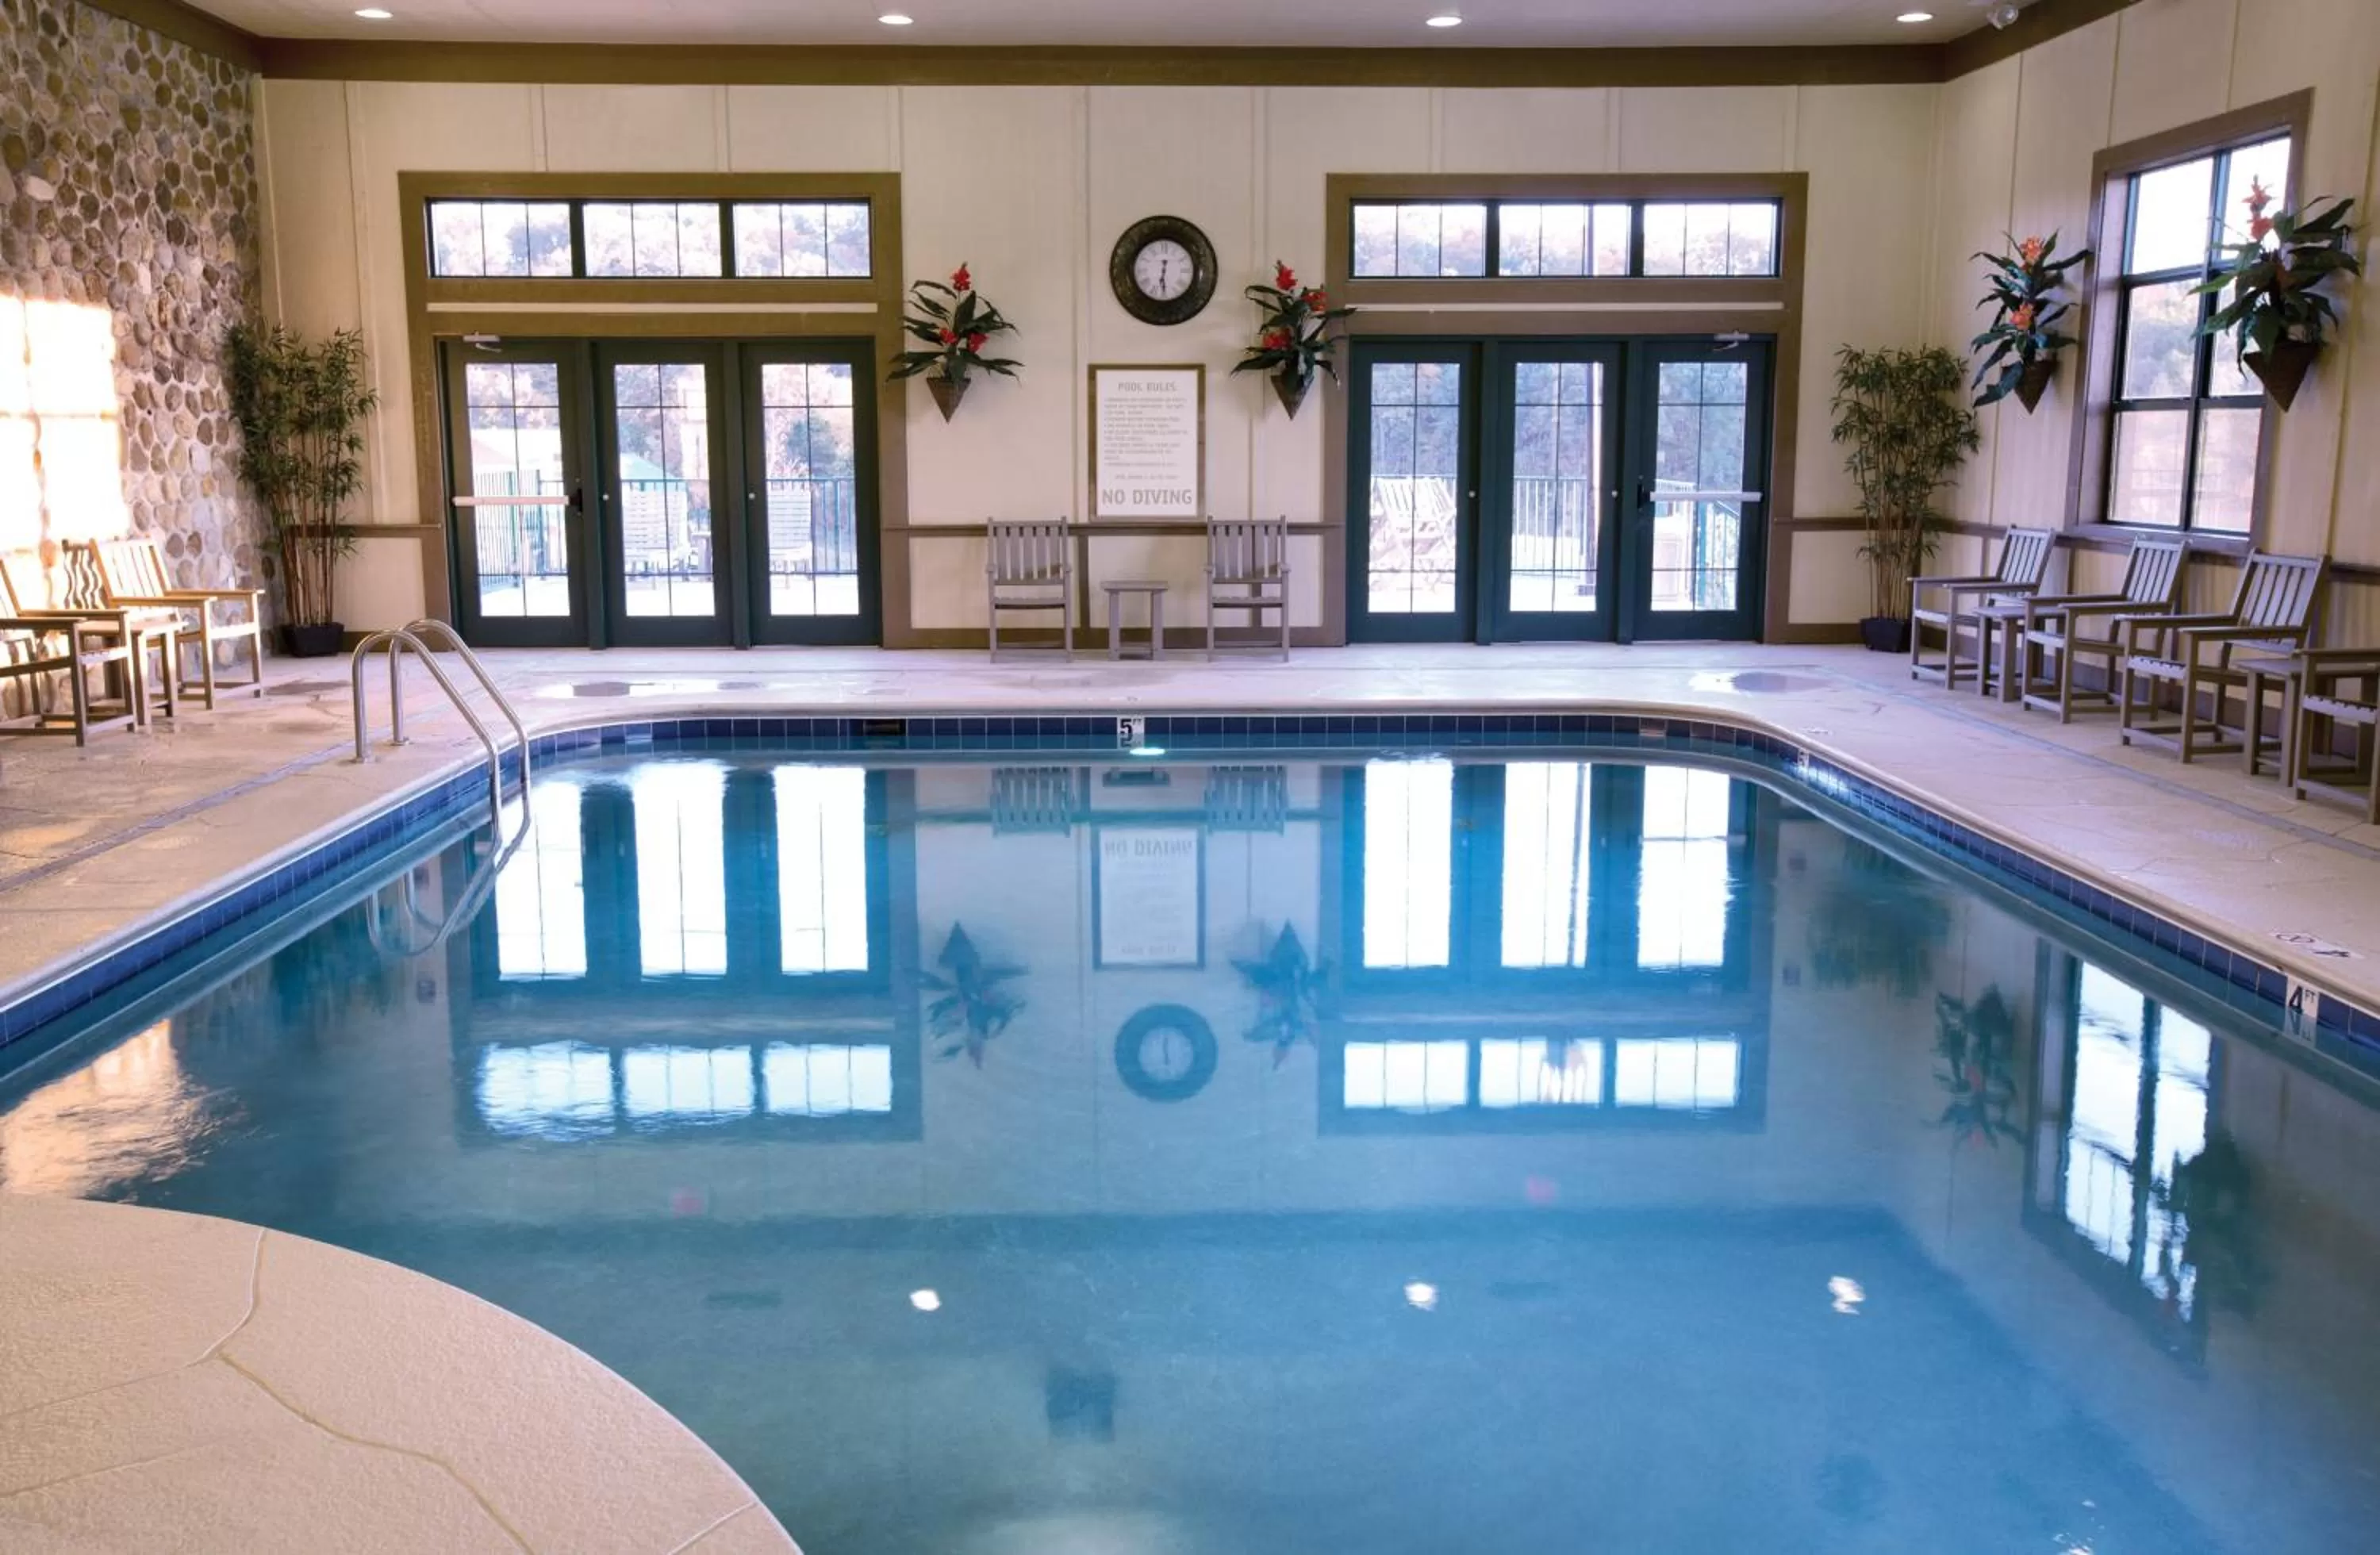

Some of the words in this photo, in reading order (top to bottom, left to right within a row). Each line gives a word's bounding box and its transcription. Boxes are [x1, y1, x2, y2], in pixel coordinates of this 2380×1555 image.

[1103, 489, 1126, 505] NO
[1133, 489, 1192, 505] DIVING
[2288, 985, 2303, 1015] 4
